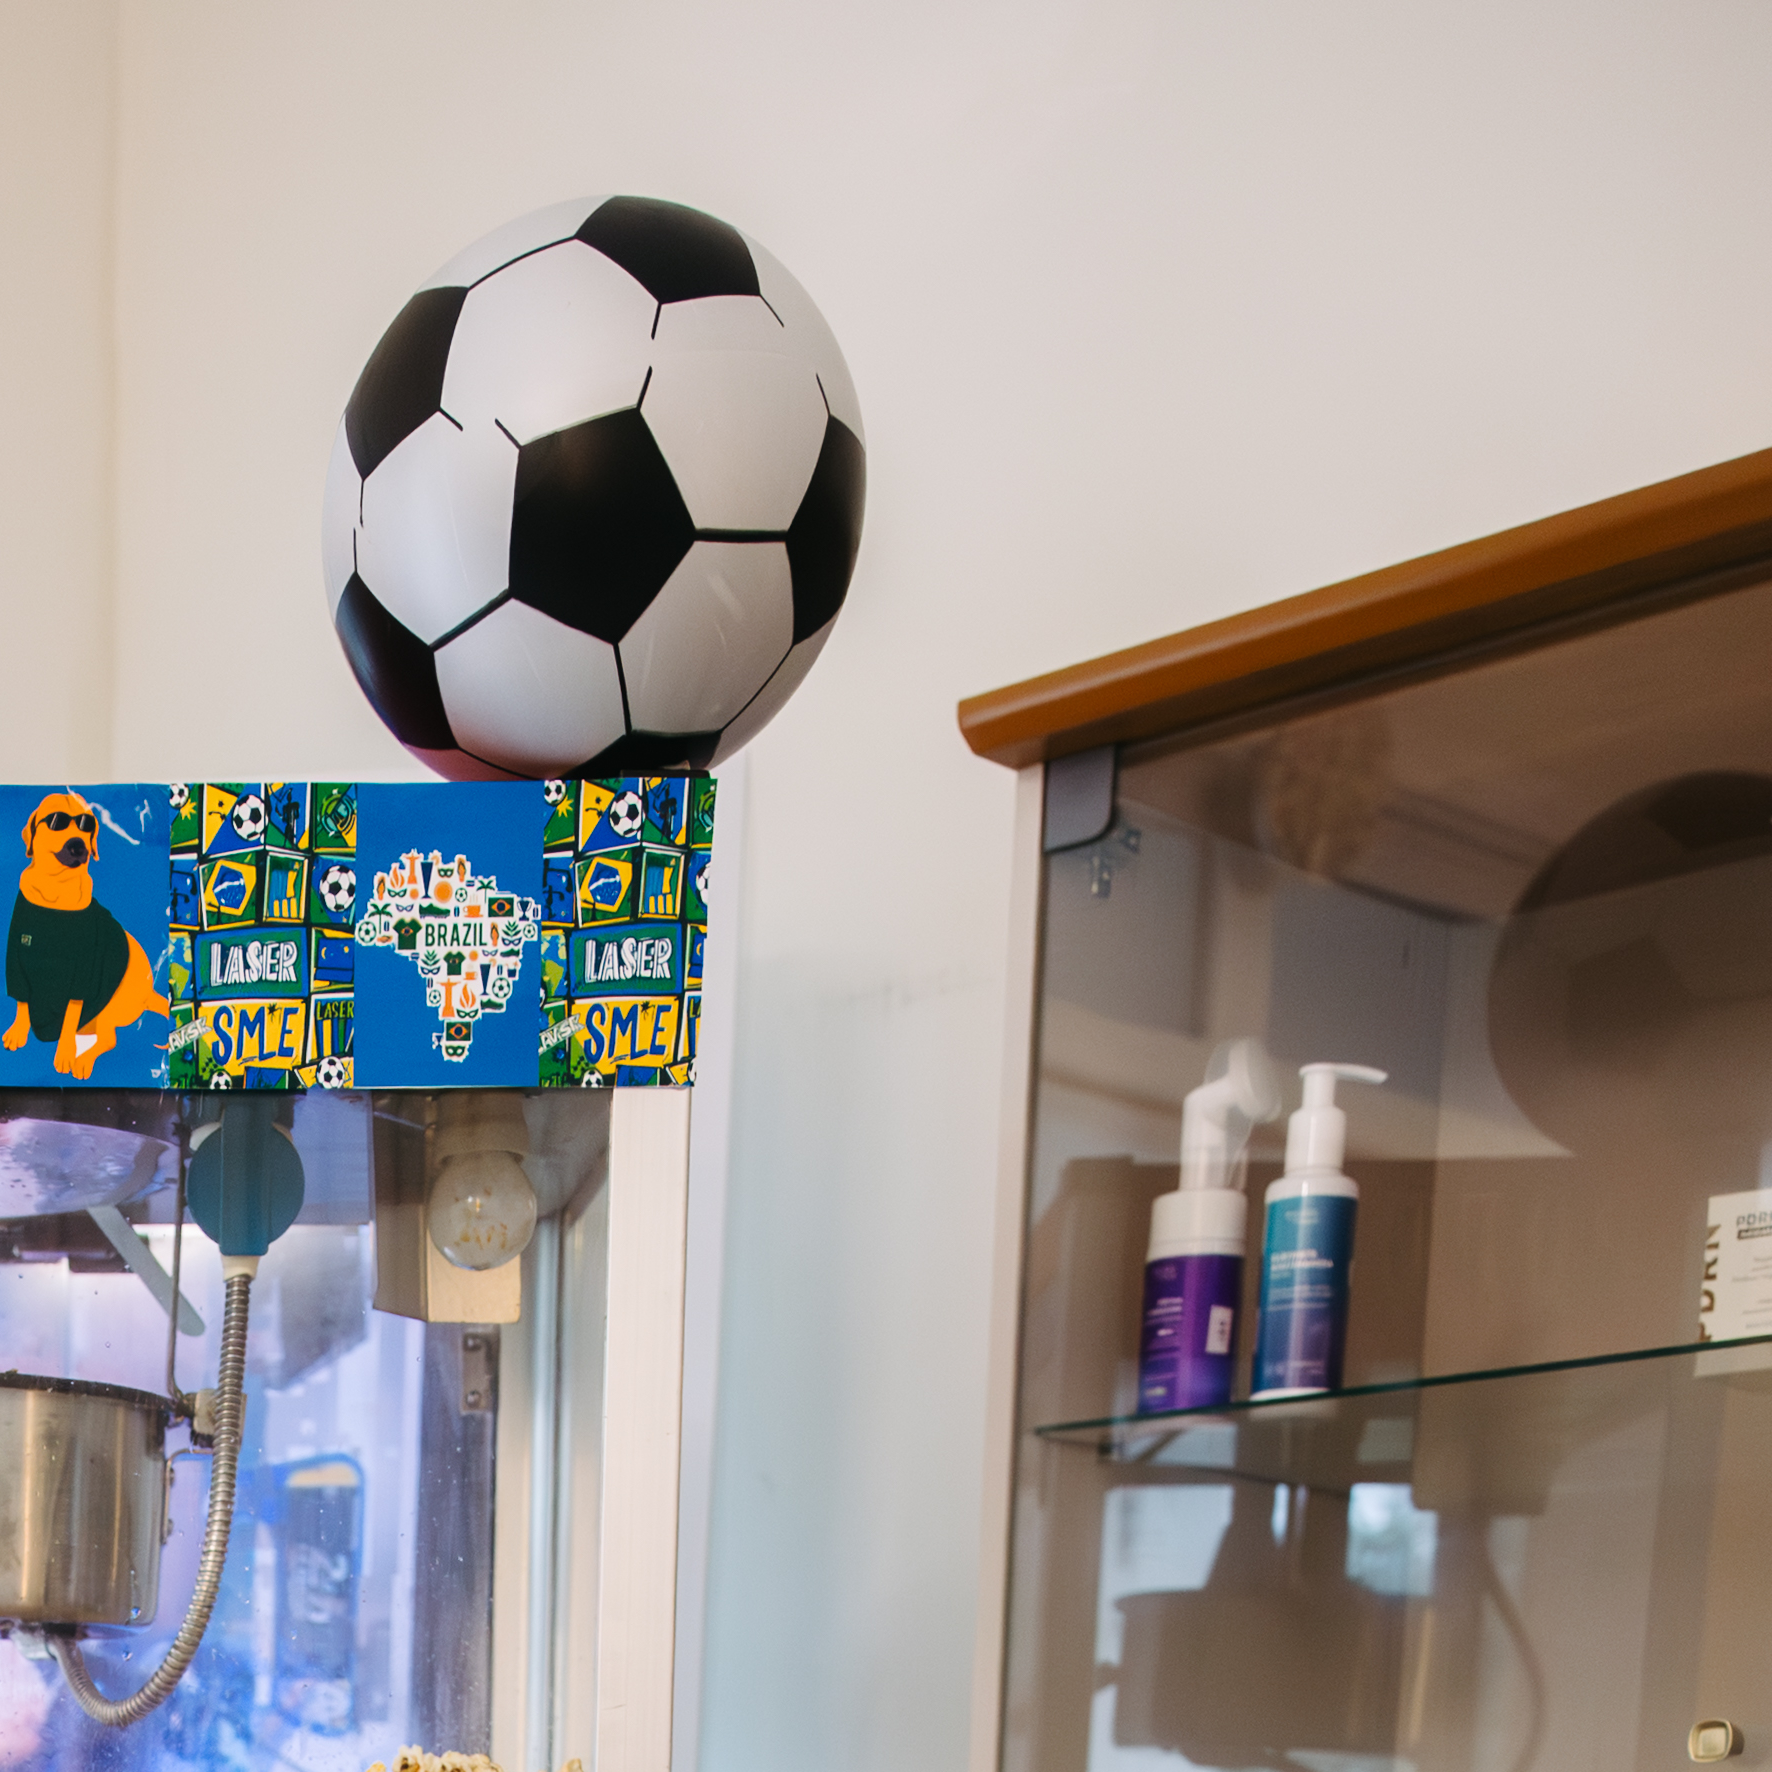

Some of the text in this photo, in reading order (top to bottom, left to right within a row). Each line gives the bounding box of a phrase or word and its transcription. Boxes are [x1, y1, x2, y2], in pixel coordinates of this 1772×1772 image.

[425, 923, 488, 948] BRAZIL
[210, 941, 297, 986] LASER
[585, 937, 672, 983] LASER
[317, 1001, 354, 1020] LASER
